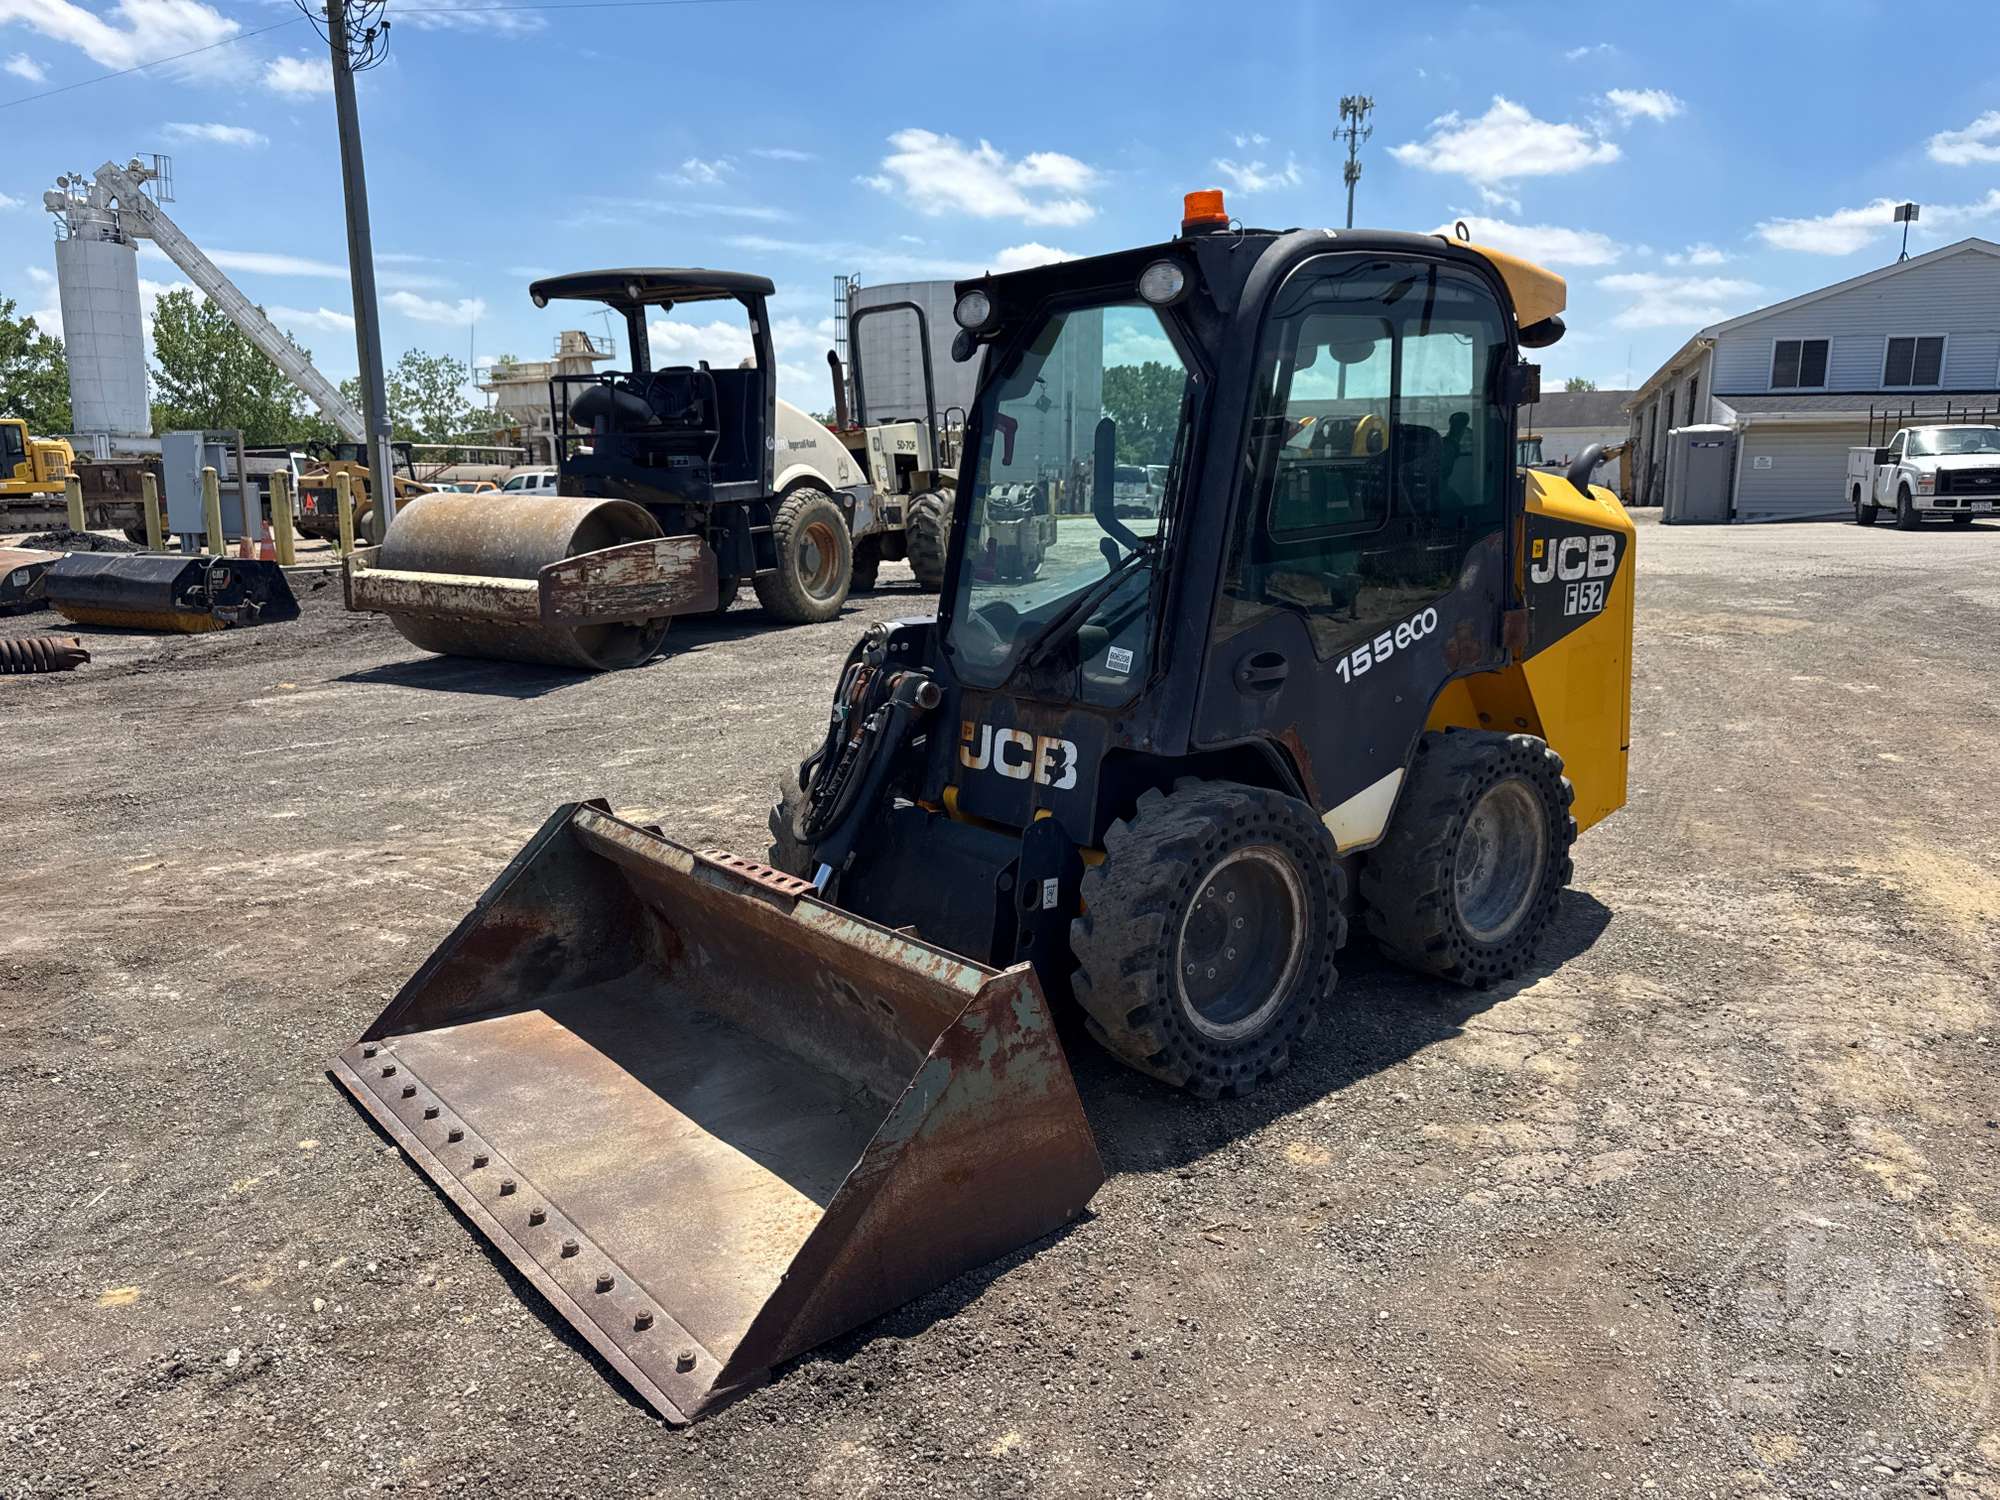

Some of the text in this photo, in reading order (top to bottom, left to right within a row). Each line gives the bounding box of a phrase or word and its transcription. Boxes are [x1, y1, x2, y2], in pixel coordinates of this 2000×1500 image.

[212, 570, 224, 579] CAT
[1531, 535, 1616, 584] JCB
[960, 722, 1078, 790] JCB
